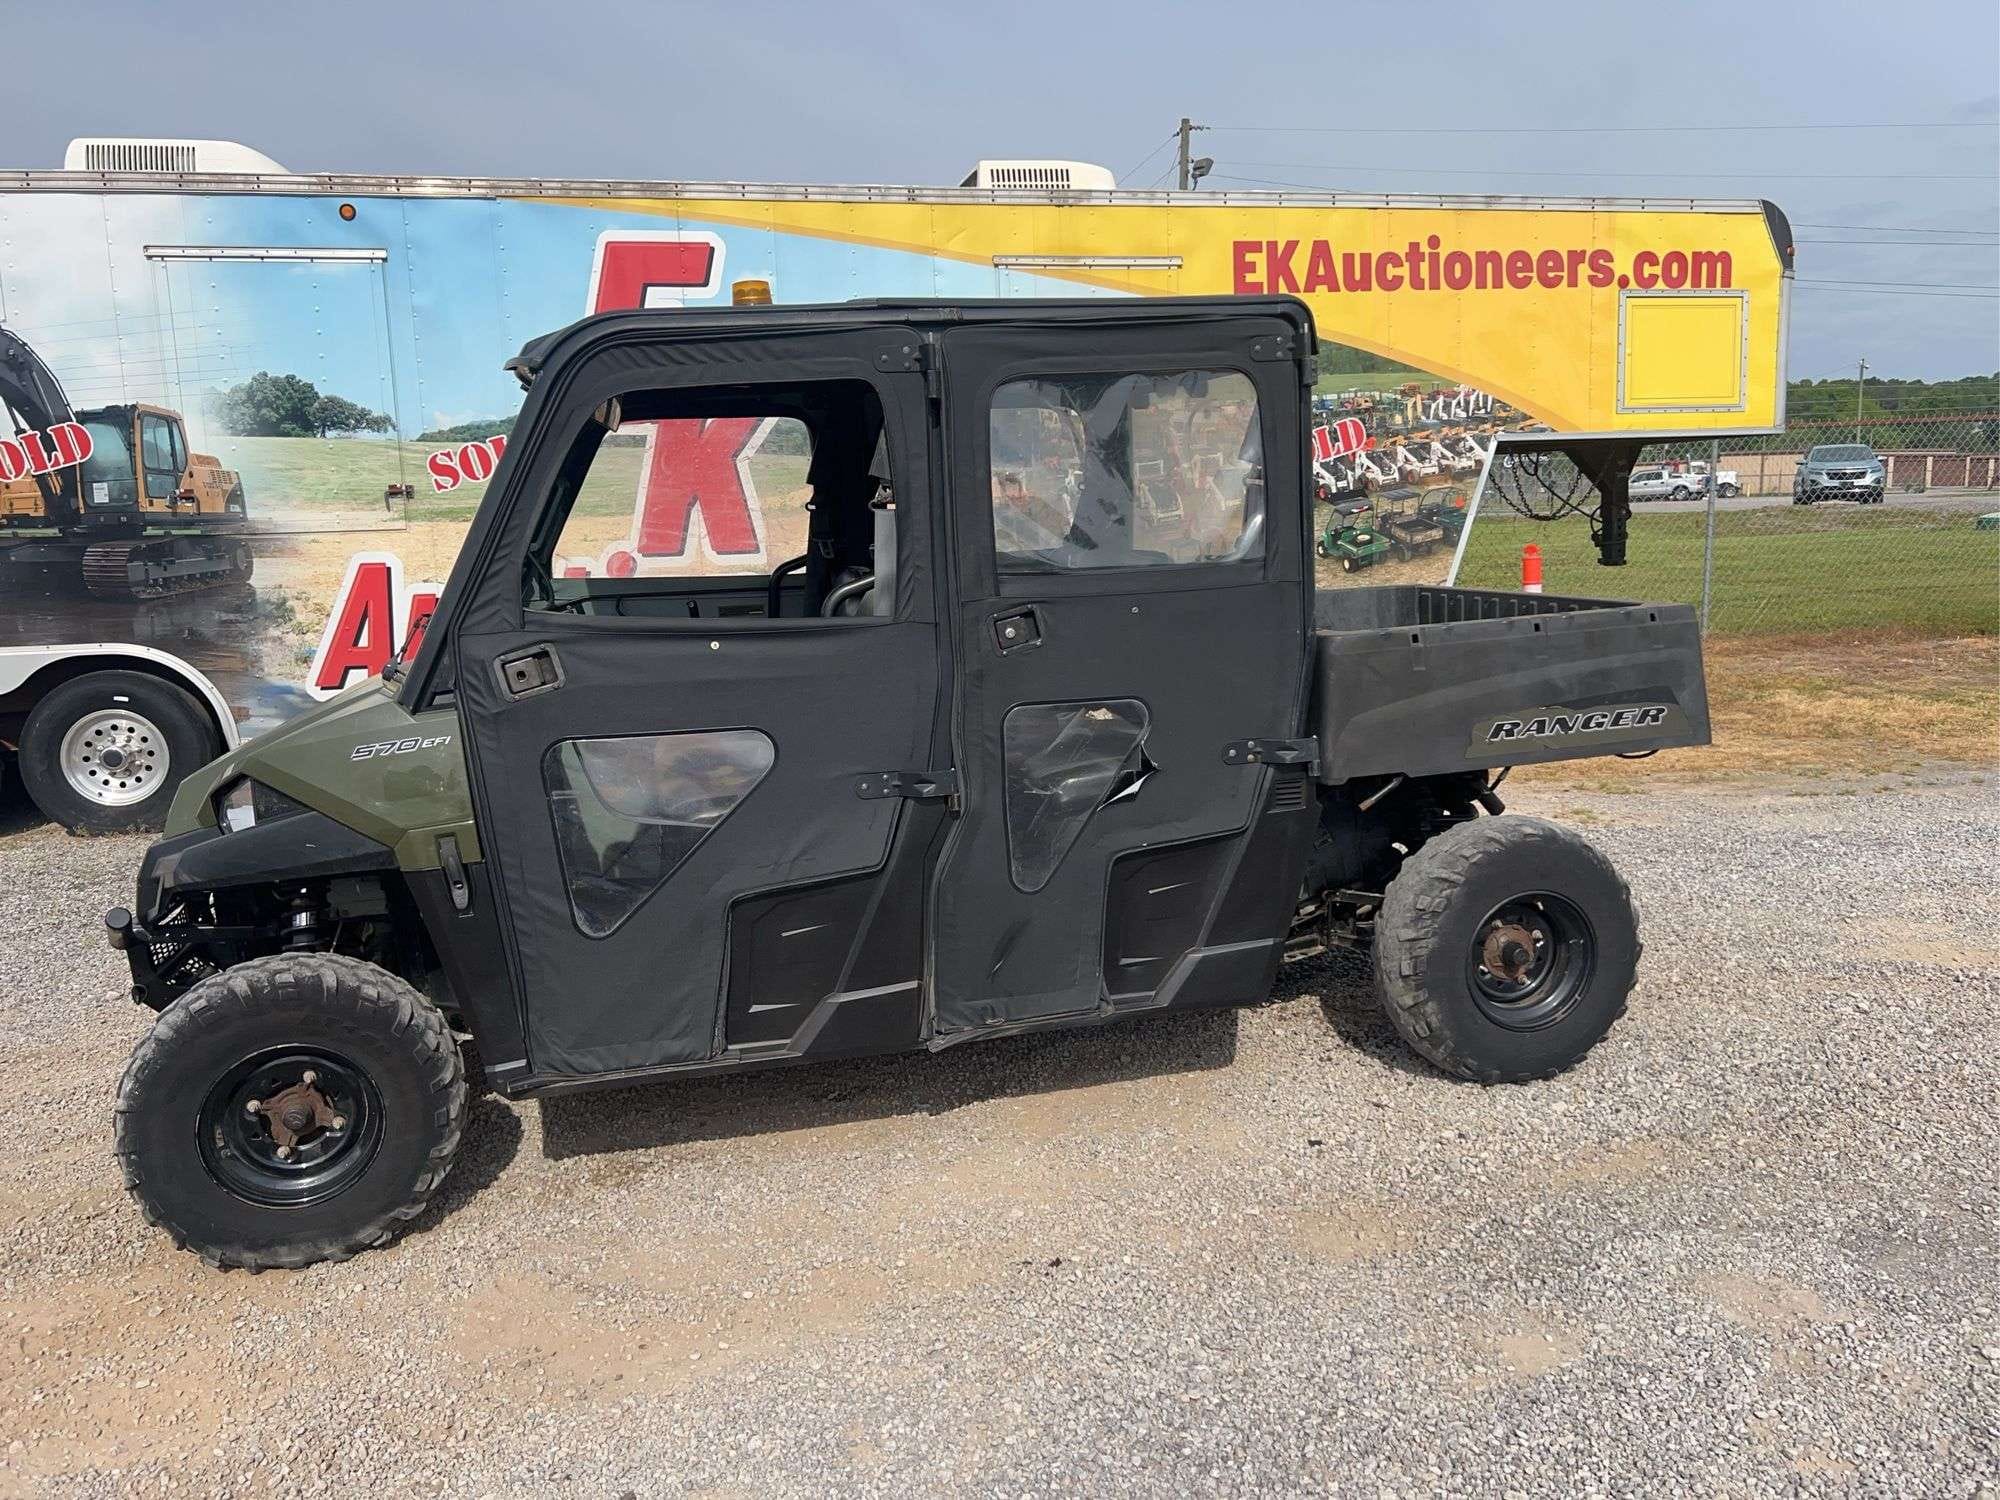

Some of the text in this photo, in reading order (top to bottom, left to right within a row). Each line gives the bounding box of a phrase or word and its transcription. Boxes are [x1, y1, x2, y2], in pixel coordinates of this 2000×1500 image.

[1232, 234, 1732, 295] EKAuctioneers.com
[1486, 706, 1667, 742] RANGER
[350, 735, 451, 761] 570 EFI
